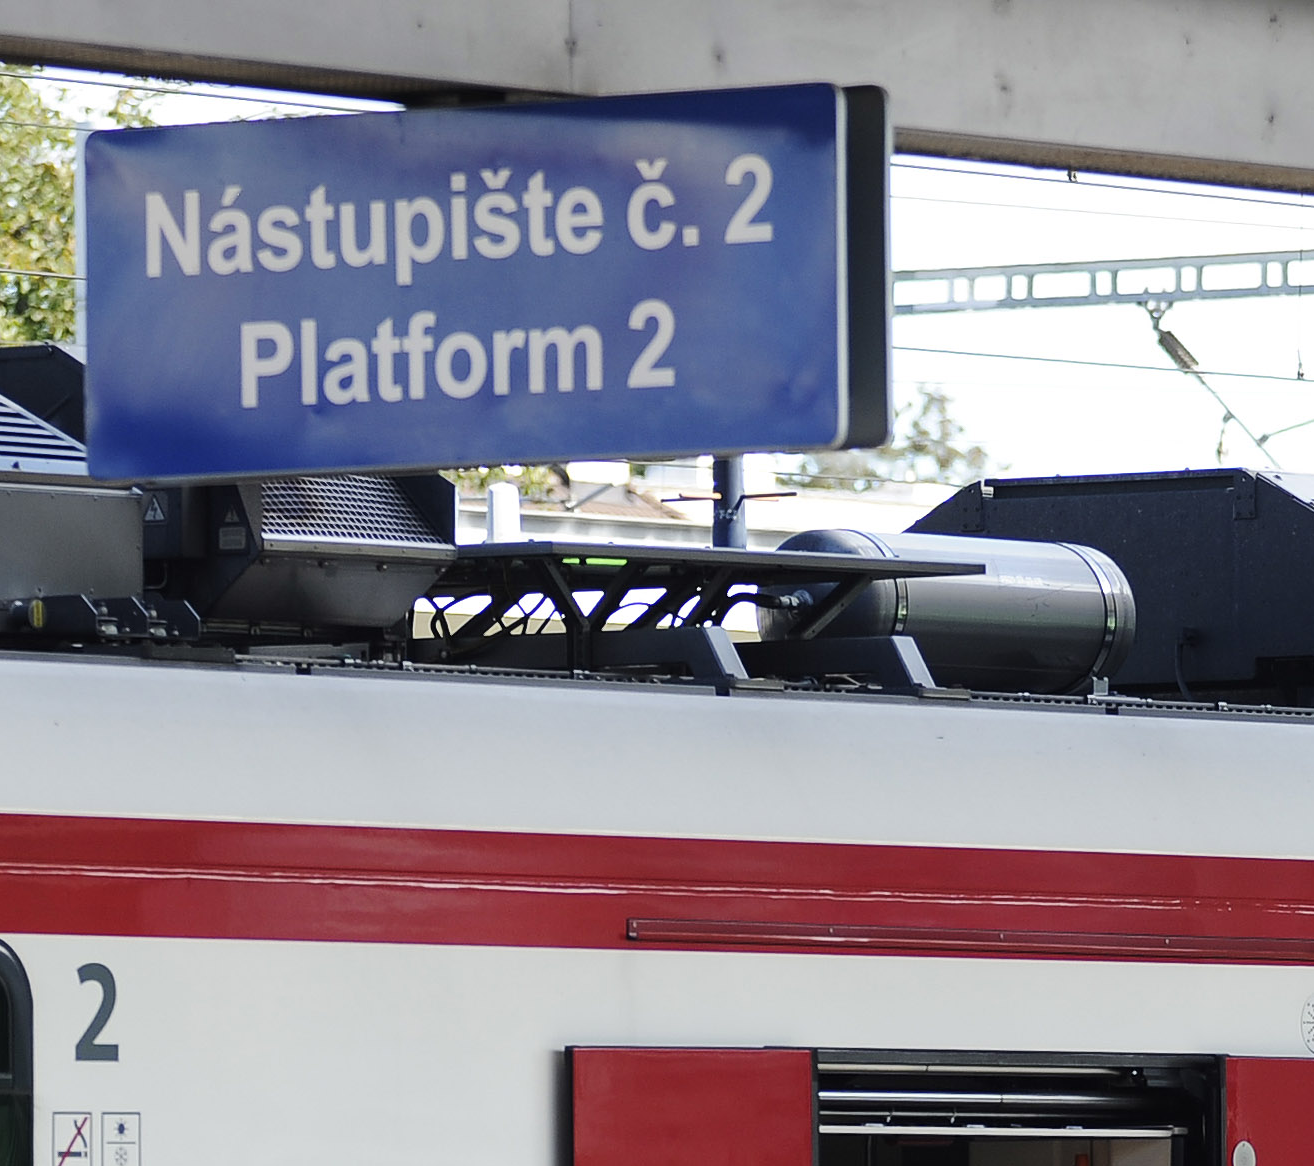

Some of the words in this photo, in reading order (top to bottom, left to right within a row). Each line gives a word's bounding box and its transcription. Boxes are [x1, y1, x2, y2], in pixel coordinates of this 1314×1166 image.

[144, 168, 604, 286] Nástupište
[627, 157, 700, 251] č.
[724, 152, 773, 246] 2
[239, 310, 604, 409] Platform
[627, 299, 676, 390] 2
[74, 961, 120, 1062] 2
